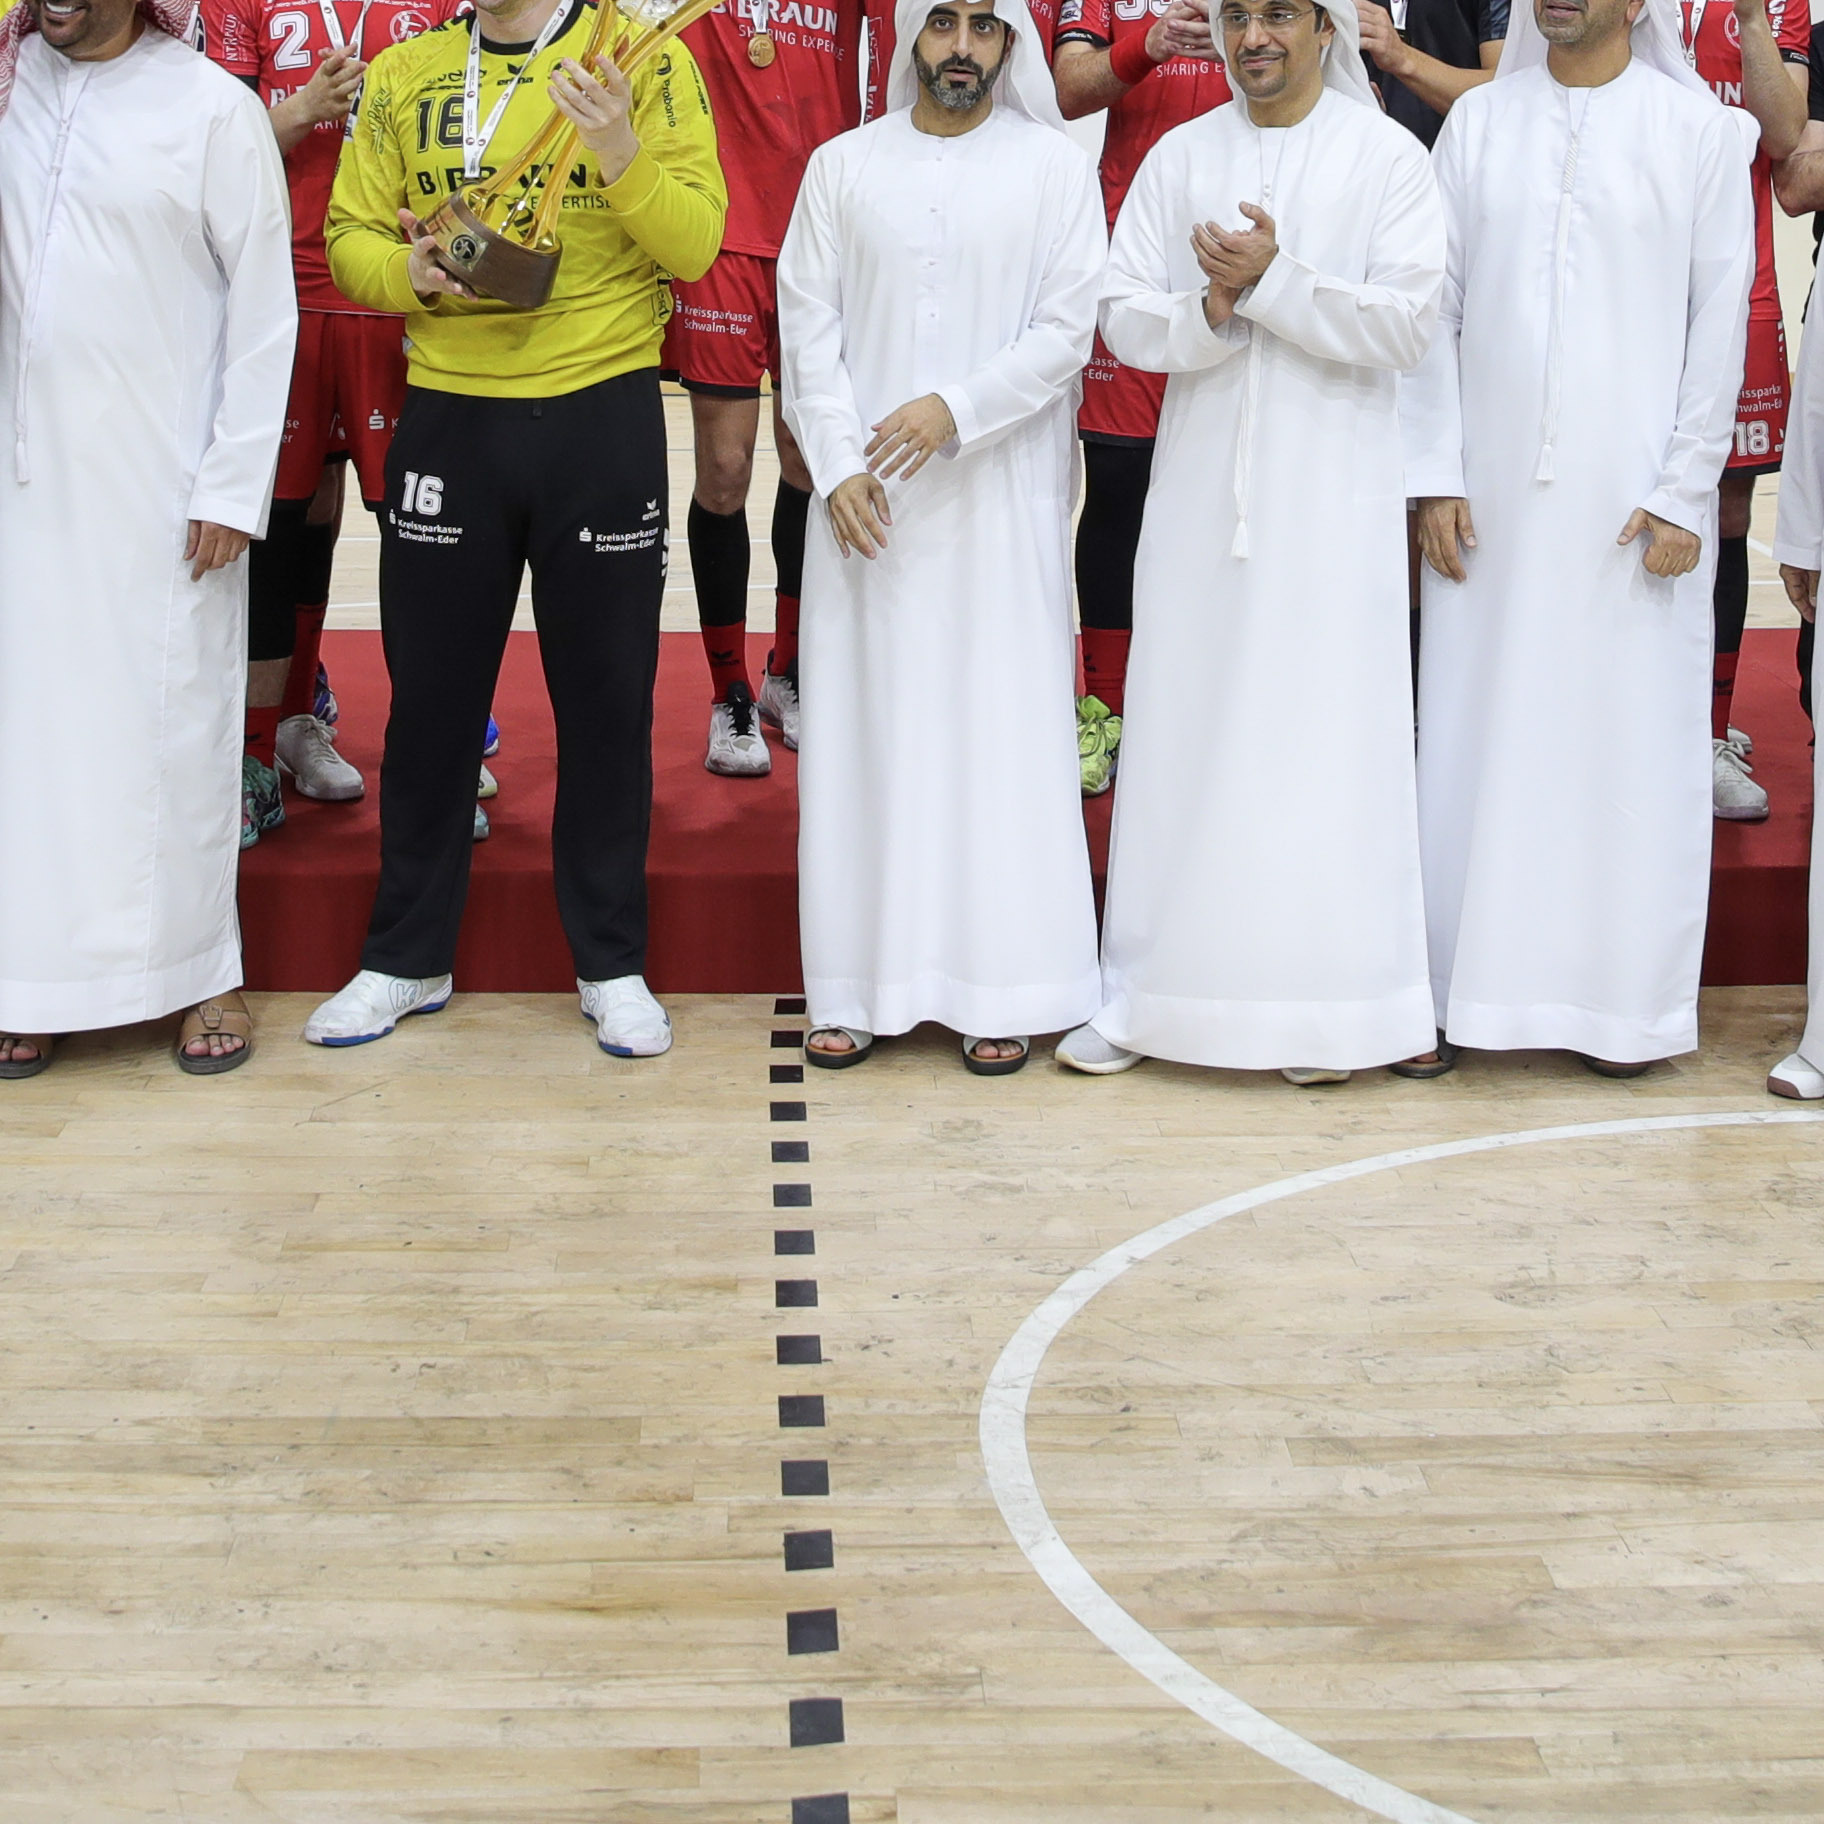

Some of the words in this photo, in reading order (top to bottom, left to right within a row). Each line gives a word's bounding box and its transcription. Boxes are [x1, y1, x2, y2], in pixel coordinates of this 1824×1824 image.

[270, 10, 311, 71] 2
[1735, 419, 1770, 456] 18
[401, 470, 444, 516] 16
